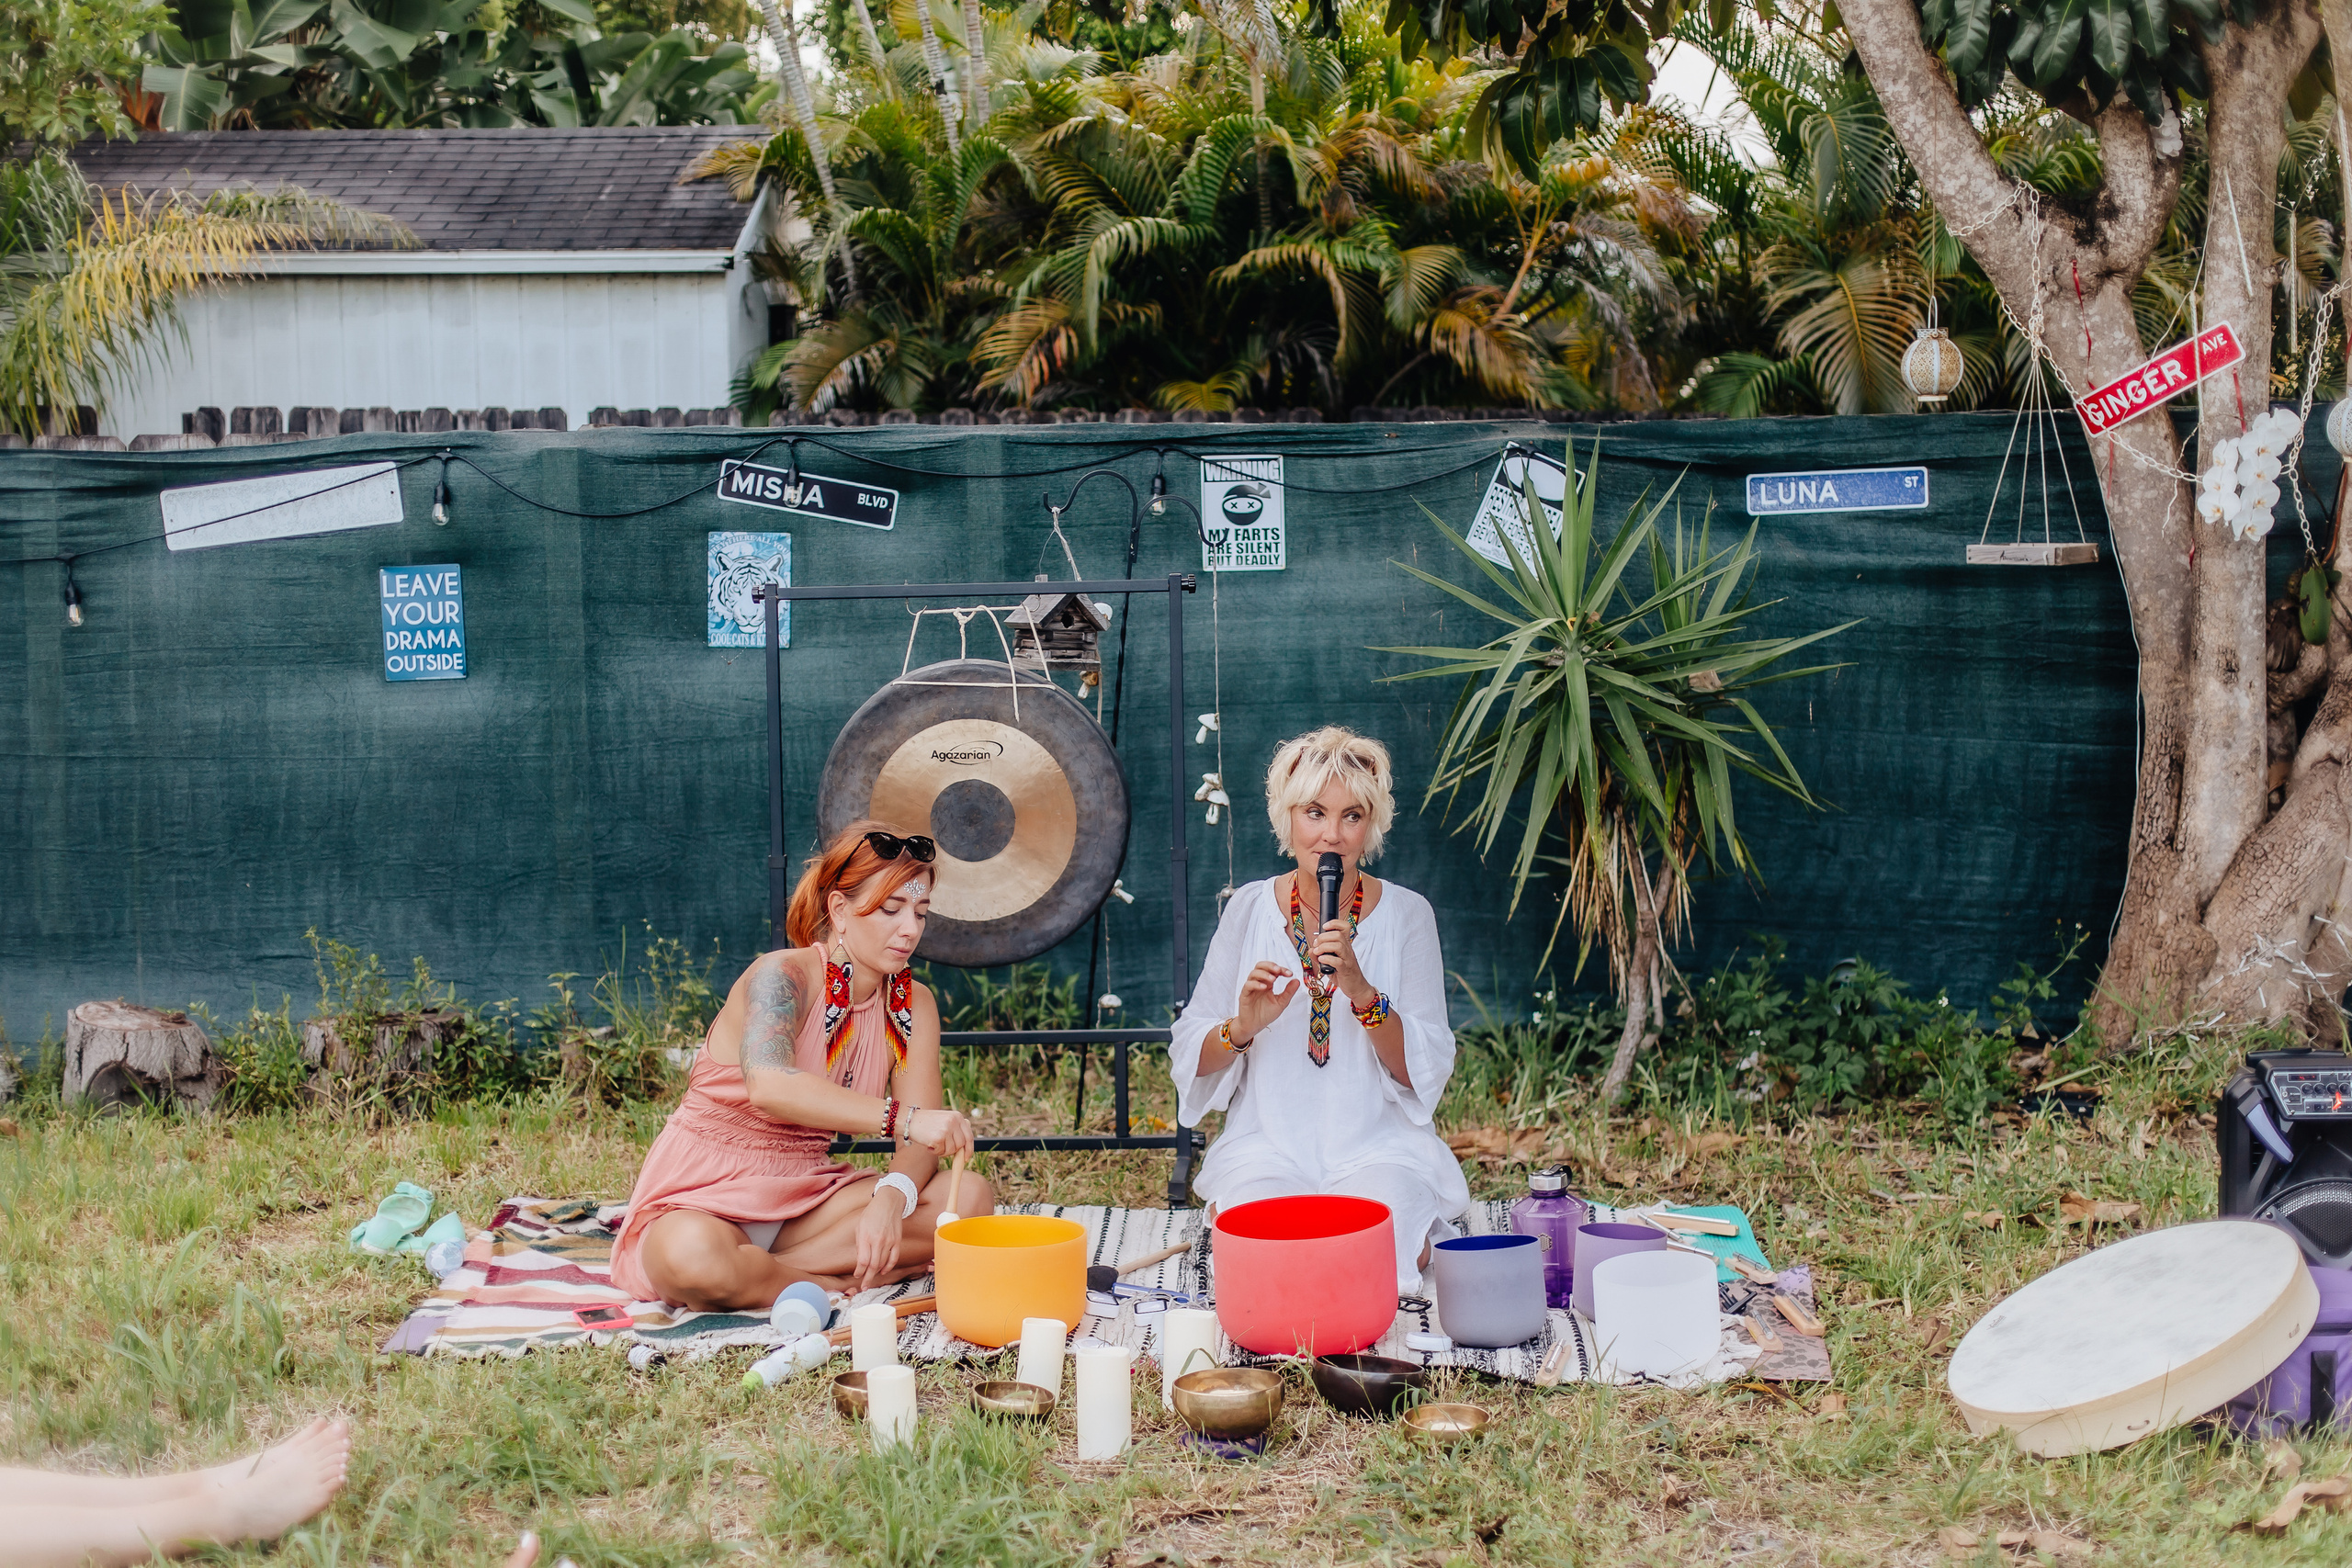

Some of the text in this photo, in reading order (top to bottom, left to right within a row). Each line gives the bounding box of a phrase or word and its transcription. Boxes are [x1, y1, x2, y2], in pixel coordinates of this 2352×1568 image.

[2087, 333, 2228, 426] GINGER AVE
[1204, 459, 1280, 481] WARNING
[731, 469, 889, 509] MISHA BLVD
[1759, 476, 1919, 506] LUNA ST
[1234, 527, 1281, 541] FARTS
[710, 535, 790, 556] HEY THERE ALL YOU
[1208, 542, 1281, 554] ARE SILENT
[1208, 554, 1281, 566] BUT DEADLY
[382, 572, 459, 598] LEAVE
[384, 600, 460, 626] YOUR
[386, 628, 462, 651] DRAMA
[710, 633, 731, 645] COOL
[731, 633, 749, 646] CATS
[750, 633, 756, 646] &
[387, 652, 464, 672] OUTSIDE
[931, 750, 991, 762] Agazarian
